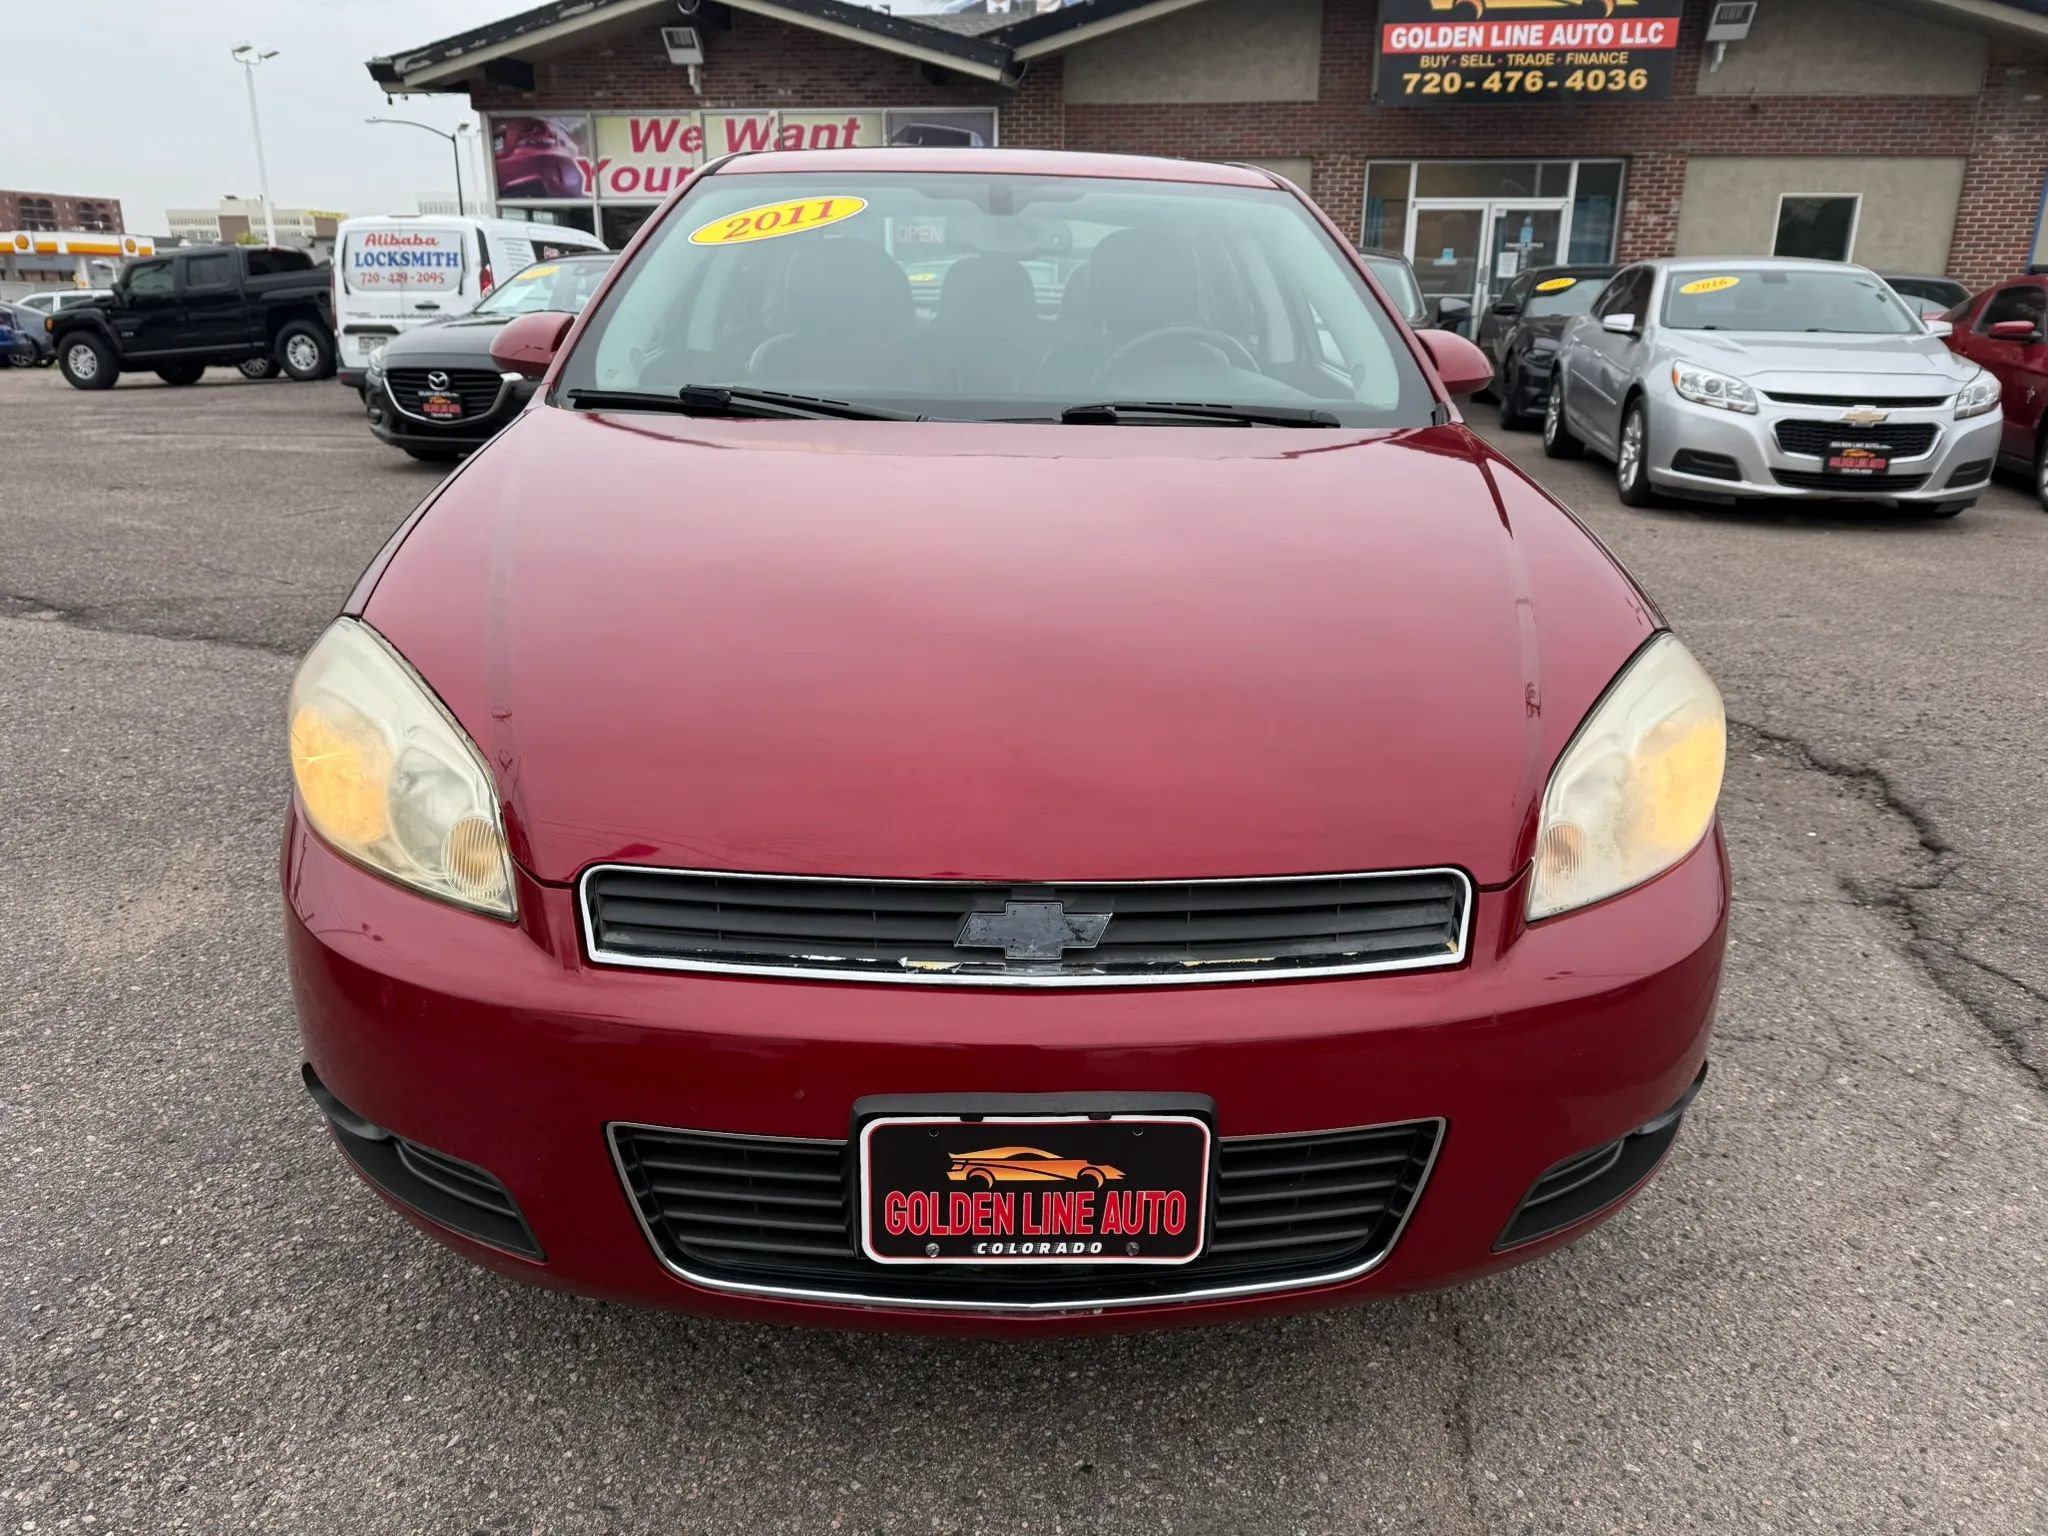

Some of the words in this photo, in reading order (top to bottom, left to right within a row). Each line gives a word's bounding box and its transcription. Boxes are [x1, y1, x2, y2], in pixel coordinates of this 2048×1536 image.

[1391, 23, 1484, 49] GOLDEN
[1490, 23, 1544, 48] LINE
[1549, 22, 1614, 47] AUTO
[1620, 21, 1664, 45] LLC
[1420, 54, 1449, 68] BUY
[1459, 54, 1495, 67] SELL
[1507, 53, 1555, 67] TRADE
[1565, 51, 1628, 65] FINANCE
[629, 118, 703, 154] We
[725, 116, 860, 150] Want
[723, 199, 834, 240] 2011
[365, 233, 439, 247] Alibaba
[895, 224, 944, 244] OPEN
[355, 252, 459, 268] LOCKSMITH
[1695, 279, 1728, 292] 2016
[885, 1191, 1015, 1235] GOLDEN
[1022, 1191, 1095, 1235] LINE
[1101, 1190, 1187, 1235] AUTO
[977, 1242, 1103, 1255] COLORADO
